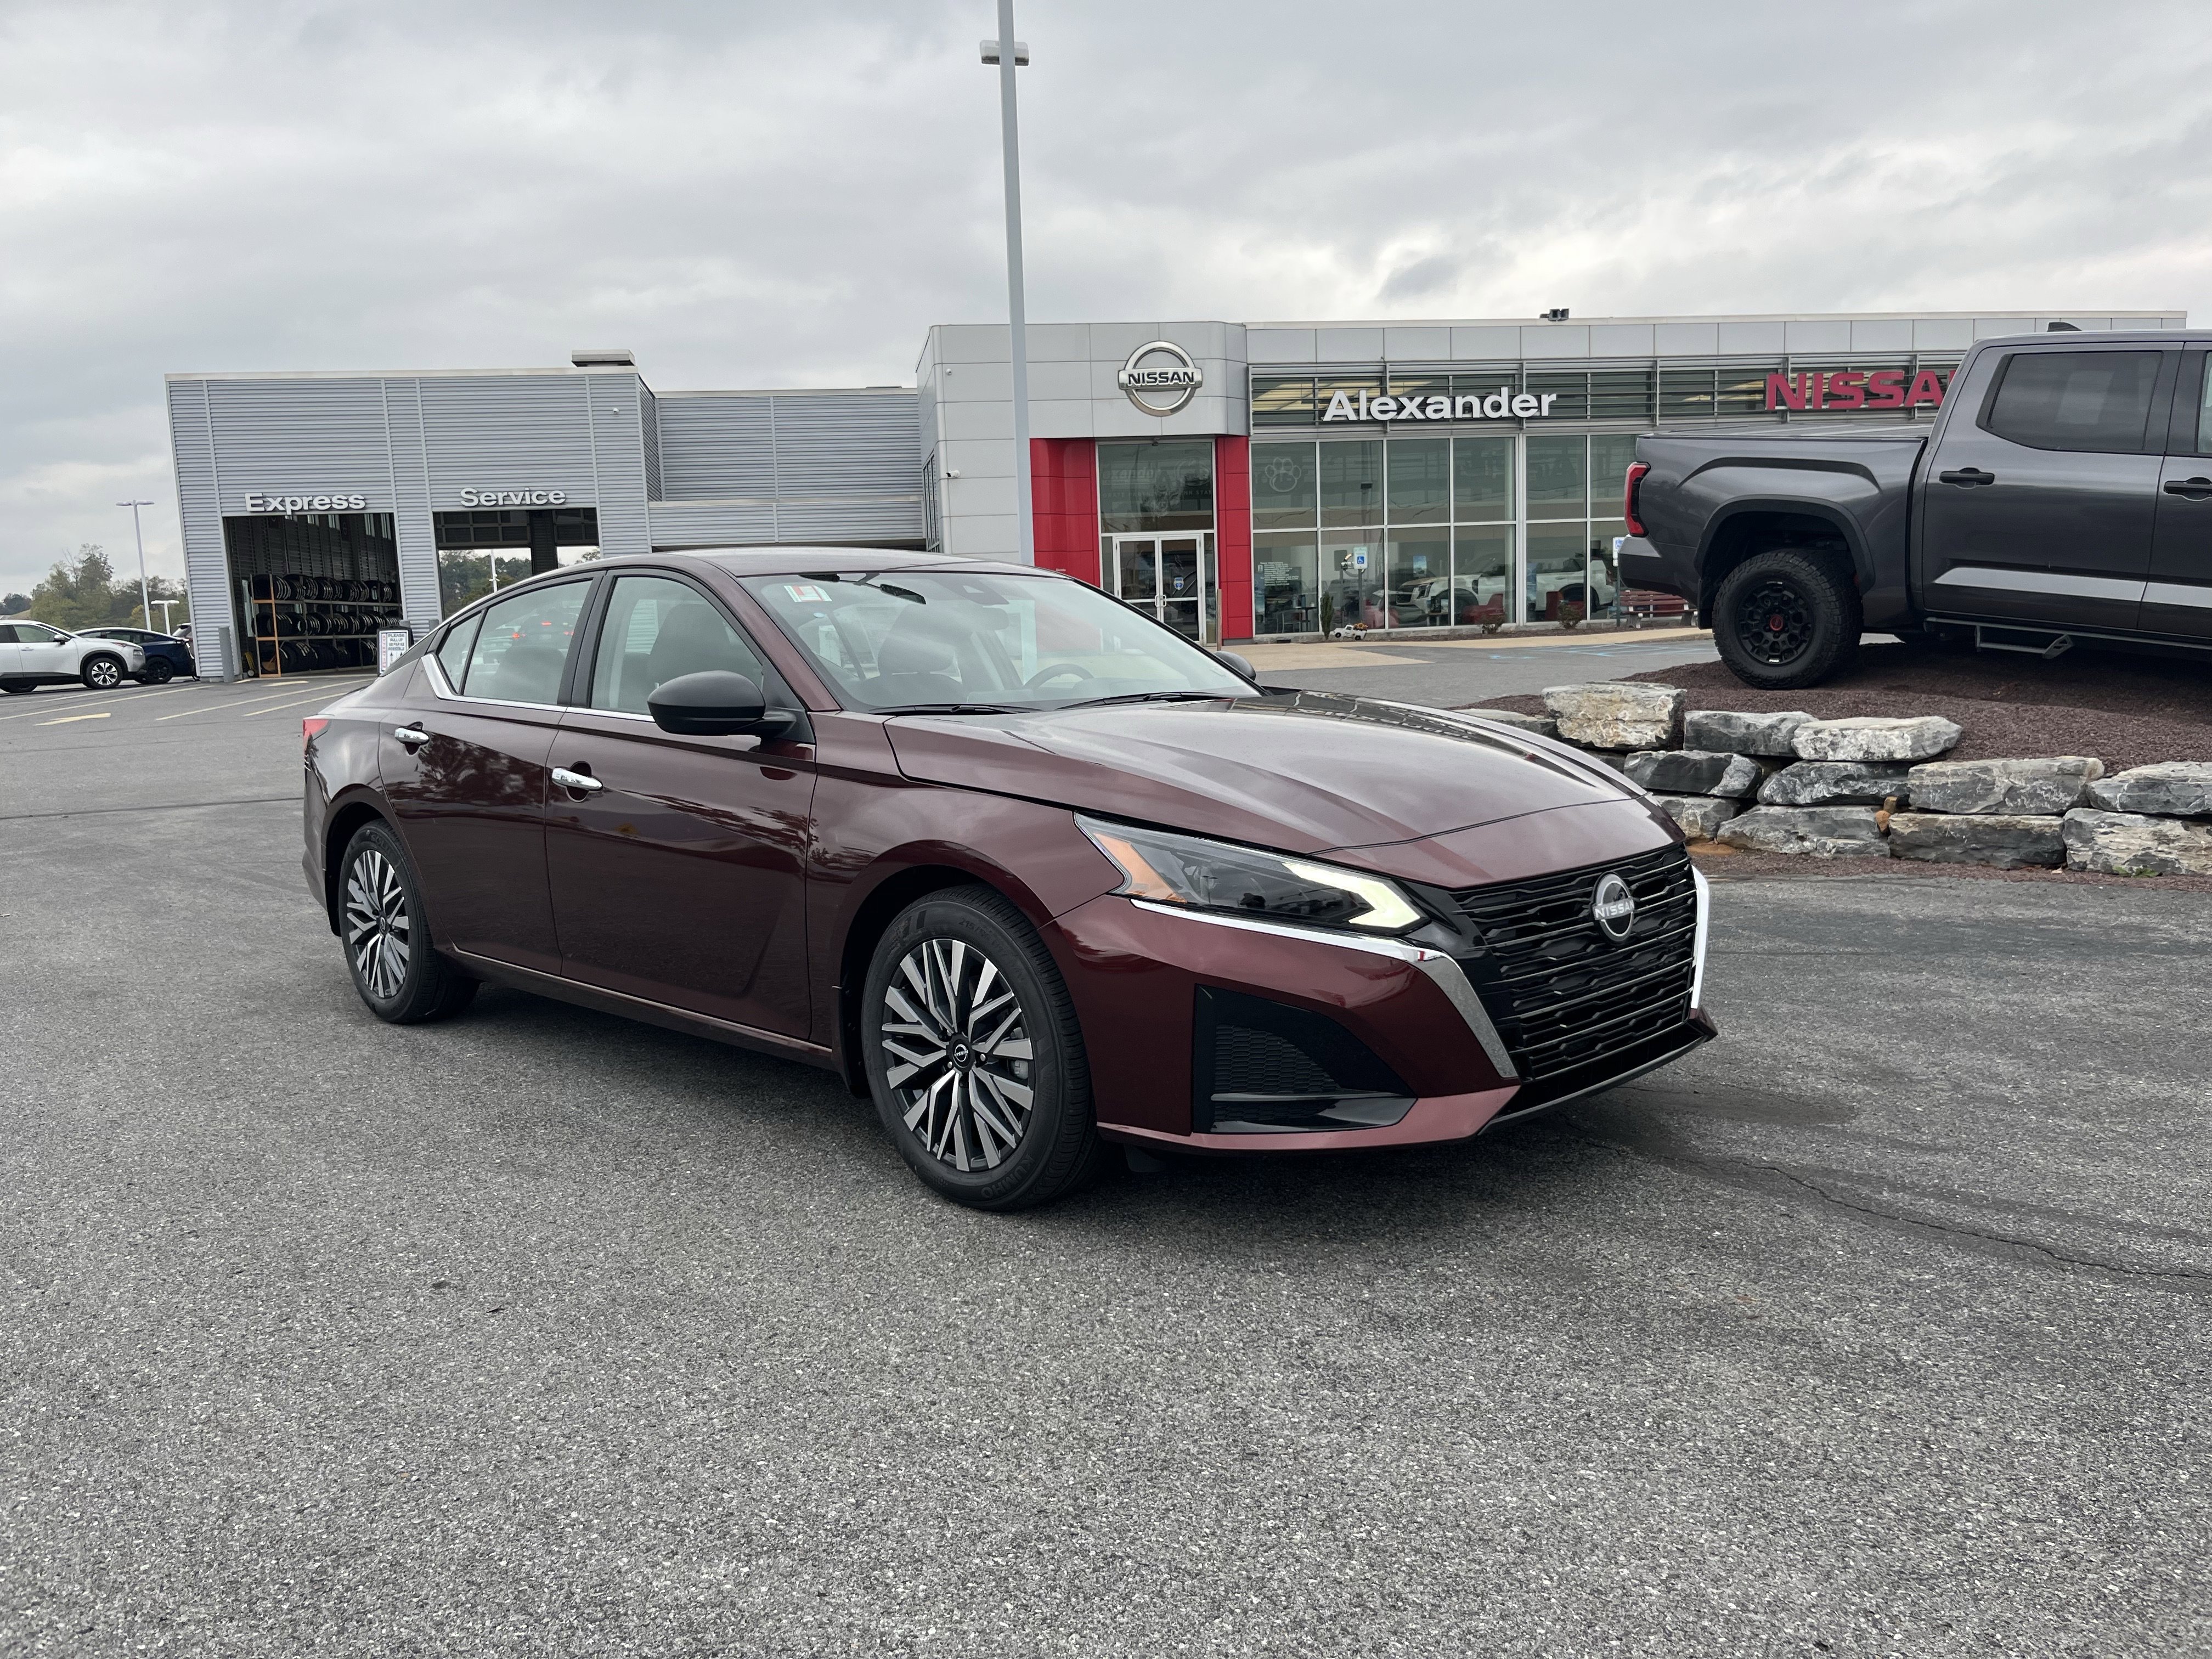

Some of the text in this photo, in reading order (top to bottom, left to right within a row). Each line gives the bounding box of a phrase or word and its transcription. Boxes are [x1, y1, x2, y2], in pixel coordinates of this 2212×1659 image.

[1127, 371, 1194, 385] NISSAN
[1765, 370, 1957, 410] NISSA
[1323, 387, 1557, 421] Alexander
[245, 493, 366, 515] Express
[460, 487, 566, 507] Service
[1594, 899, 1634, 918] NISSAN
[981, 1153, 1035, 1199] KUMHO
